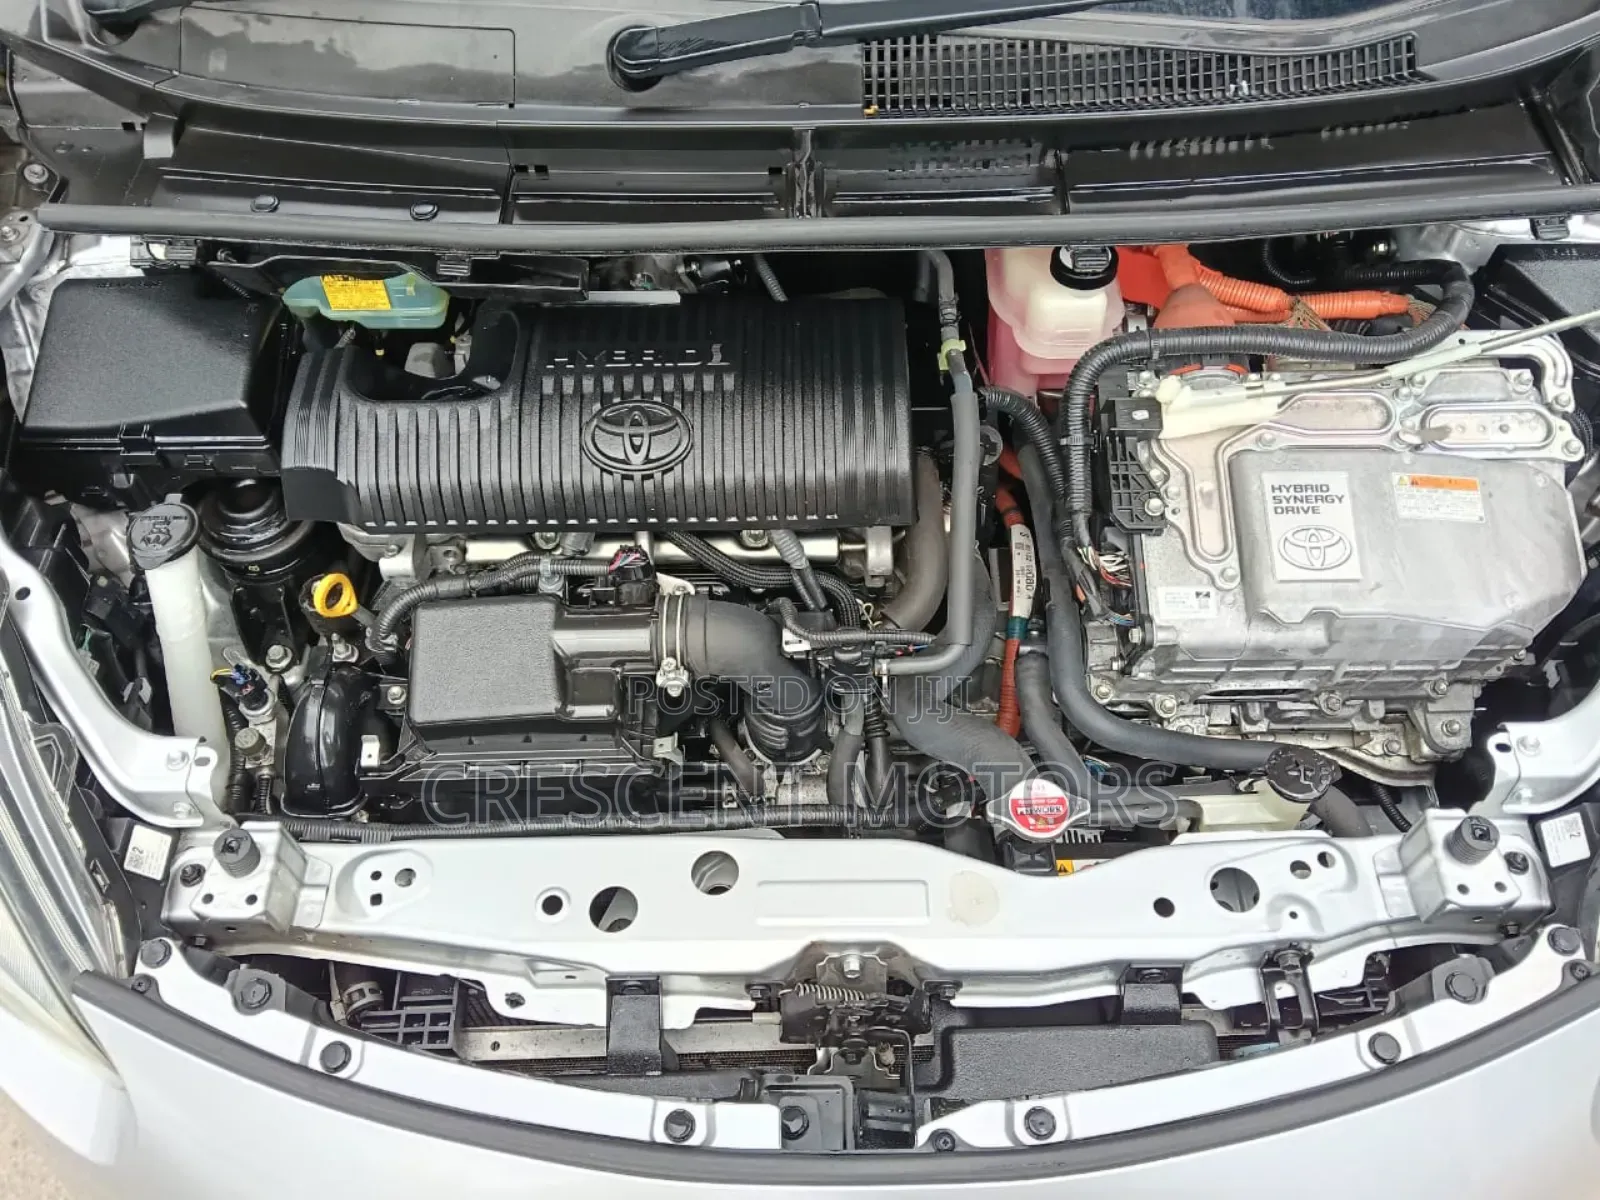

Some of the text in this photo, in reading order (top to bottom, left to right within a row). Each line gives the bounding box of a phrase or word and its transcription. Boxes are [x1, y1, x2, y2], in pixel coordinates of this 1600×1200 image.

[1271, 483, 1330, 493] HYBRID
[1272, 494, 1345, 505] SYNERGY
[1274, 505, 1321, 515] DRIVE
